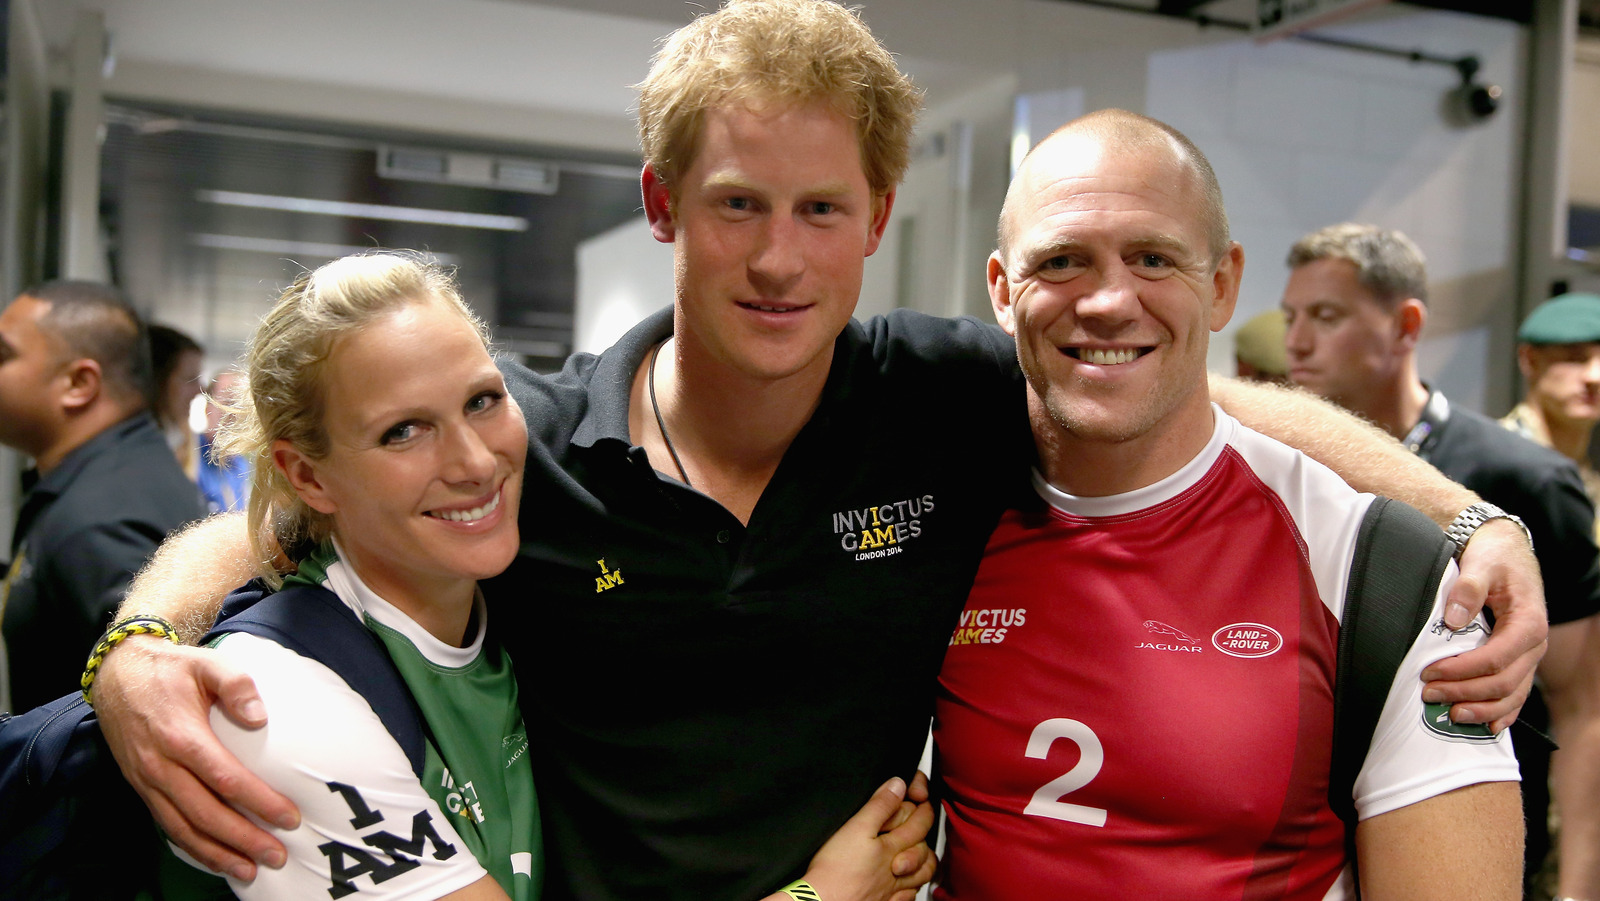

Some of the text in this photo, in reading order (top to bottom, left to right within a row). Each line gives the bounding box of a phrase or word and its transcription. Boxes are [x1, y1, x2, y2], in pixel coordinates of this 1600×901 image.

[832, 494, 935, 534] INVICTUS
[841, 520, 922, 552] GAMES
[855, 545, 904, 561] LONDON 2014
[596, 559, 609, 575] I
[595, 569, 625, 594] AM
[960, 608, 1027, 628] VICTUS
[948, 628, 1008, 647] AMES
[1134, 642, 1203, 653] JAGUAR
[1023, 717, 1108, 828] 2
[326, 781, 385, 831] I
[317, 808, 458, 901] AM
